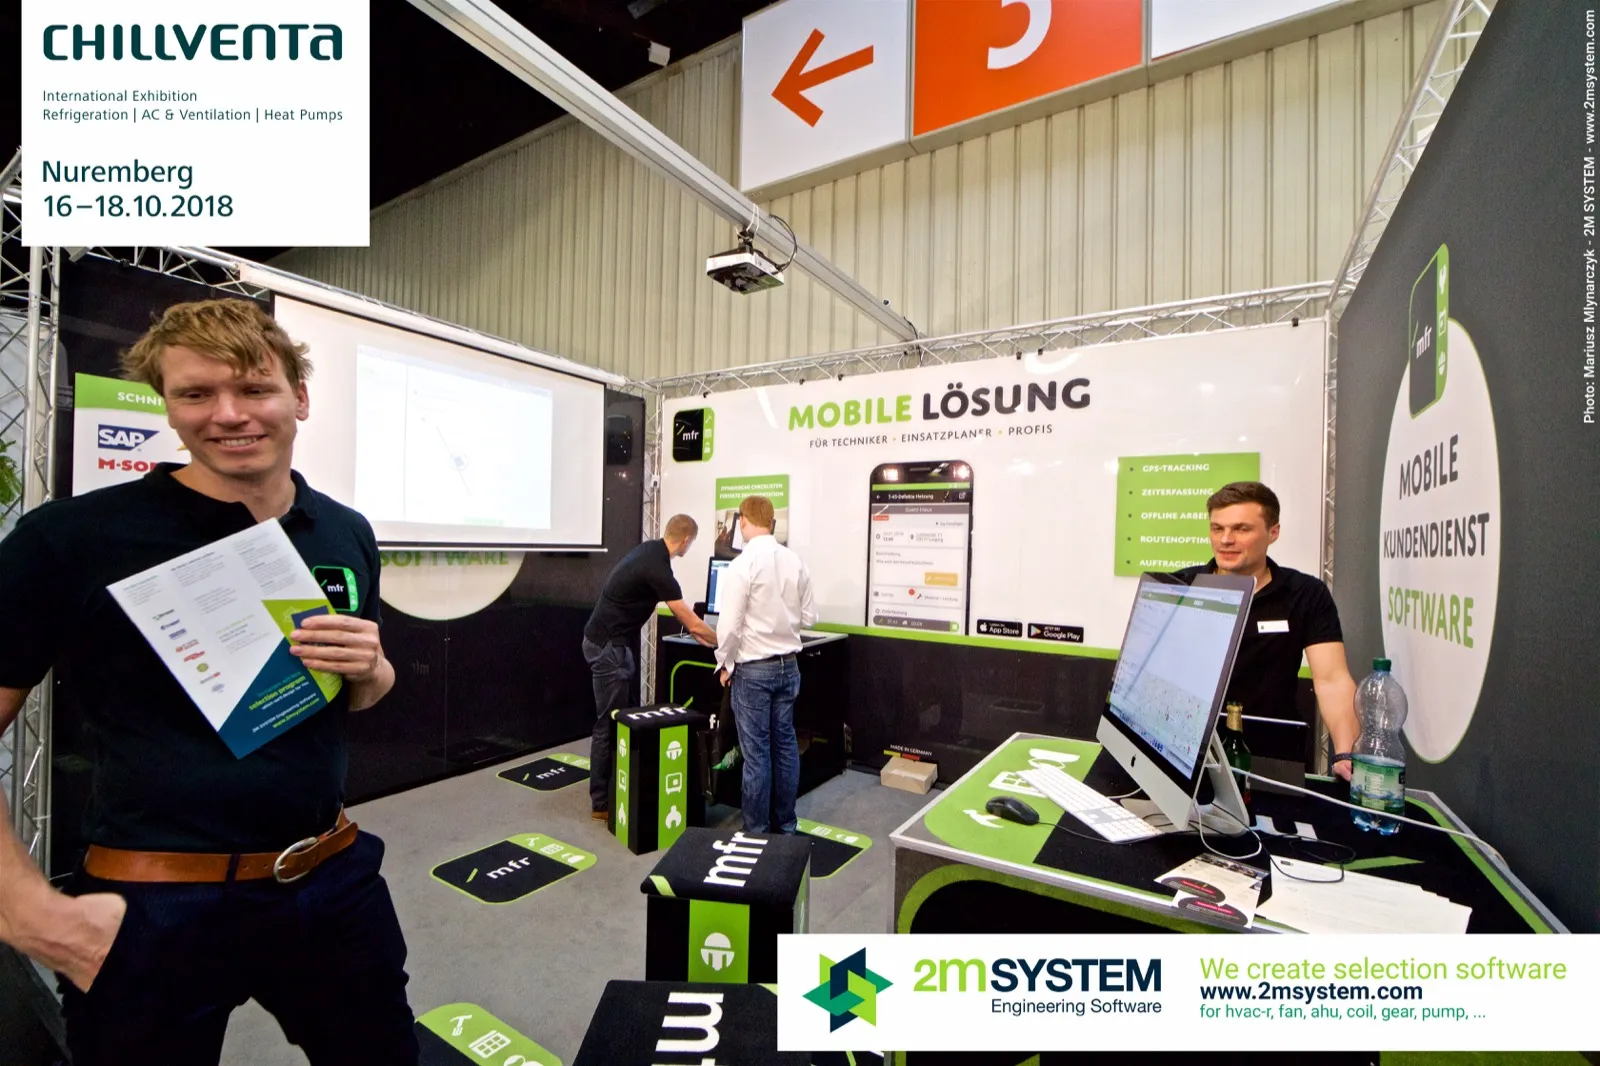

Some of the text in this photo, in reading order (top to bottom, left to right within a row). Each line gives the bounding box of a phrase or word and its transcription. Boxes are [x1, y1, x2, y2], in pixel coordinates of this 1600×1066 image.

[117, 391, 161, 406] SCHNI
[788, 377, 1091, 431] MOBILE LÖSUNG
[98, 429, 145, 447] SAP
[682, 430, 699, 441] mfr
[809, 424, 1053, 448] FÜR TECHNIKER EINSATZPLANER PROFIS
[1142, 464, 1210, 472] GPS-TRACKING
[1399, 434, 1459, 500] MOBILE
[1141, 488, 1214, 497] ZEITERFASSUNG
[1141, 512, 1208, 520] OFFLINE ARBEI
[1140, 536, 1210, 545] ROUTENOPTIM
[1383, 512, 1490, 559] KUNDENDIENST
[1387, 585, 1474, 649] SOFTWARE
[989, 626, 1019, 635] App Store
[1043, 630, 1080, 641] Google Play
[627, 707, 687, 720] mfr
[890, 744, 903, 752] MADE
[910, 748, 932, 756] GERMANY
[536, 766, 566, 779] mfr
[703, 831, 768, 887] mfr
[486, 857, 530, 879] mfr
